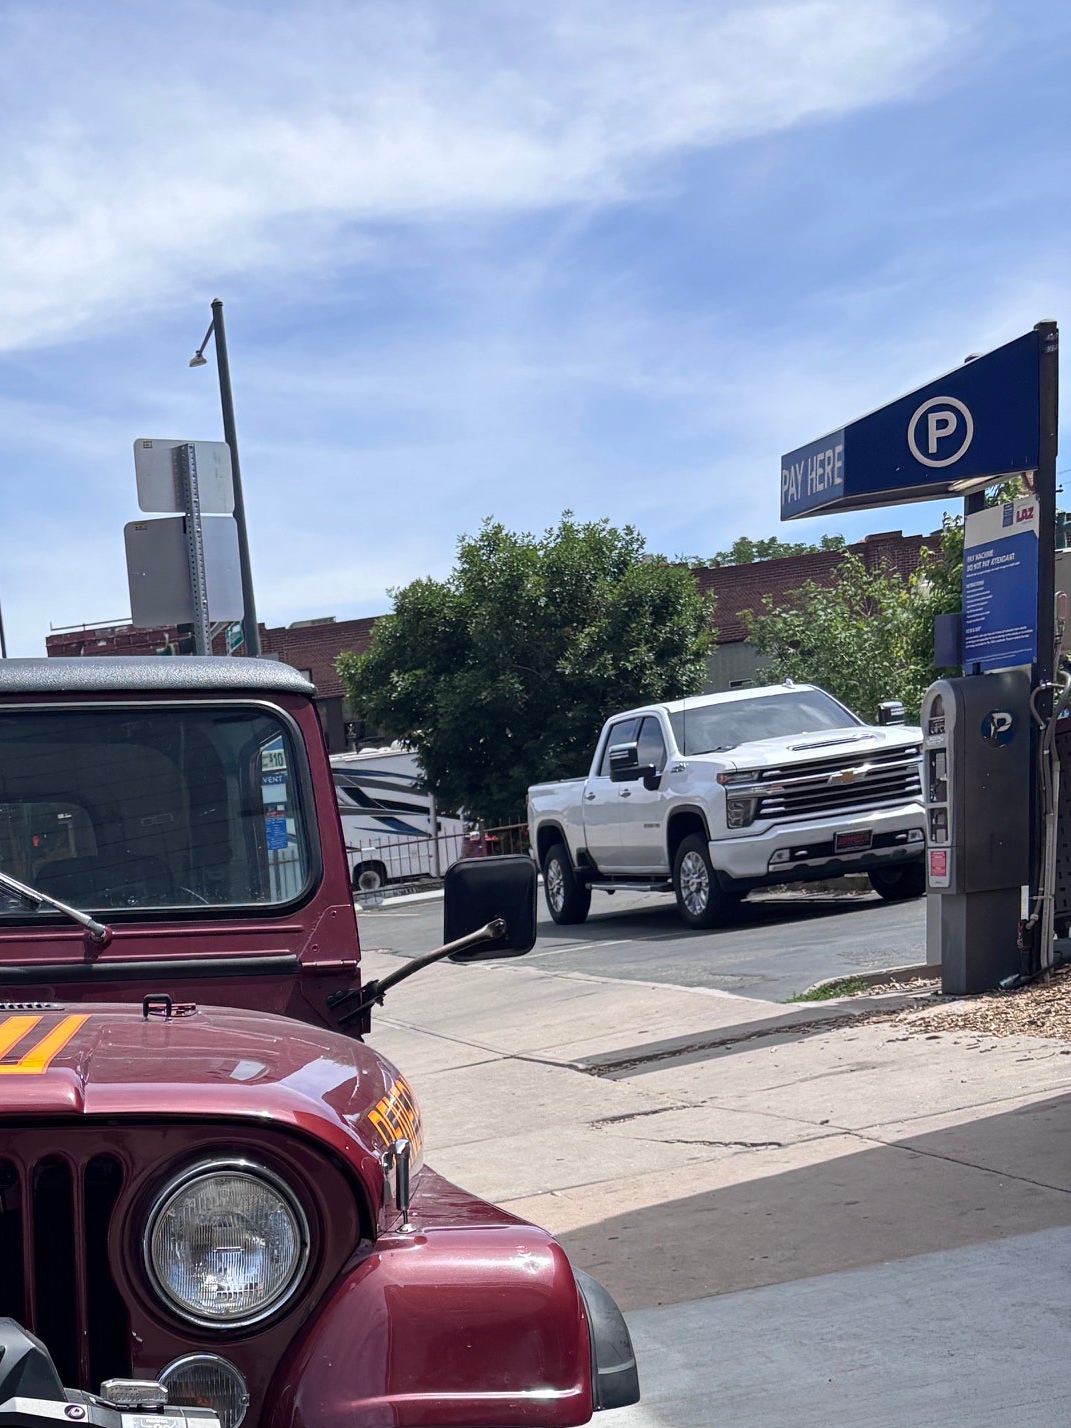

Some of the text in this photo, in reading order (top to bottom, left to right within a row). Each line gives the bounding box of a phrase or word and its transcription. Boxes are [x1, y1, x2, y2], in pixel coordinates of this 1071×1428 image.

[928, 411, 957, 454] P
[782, 445, 843, 504] PAY HERE
[262, 775, 284, 784] VENT
